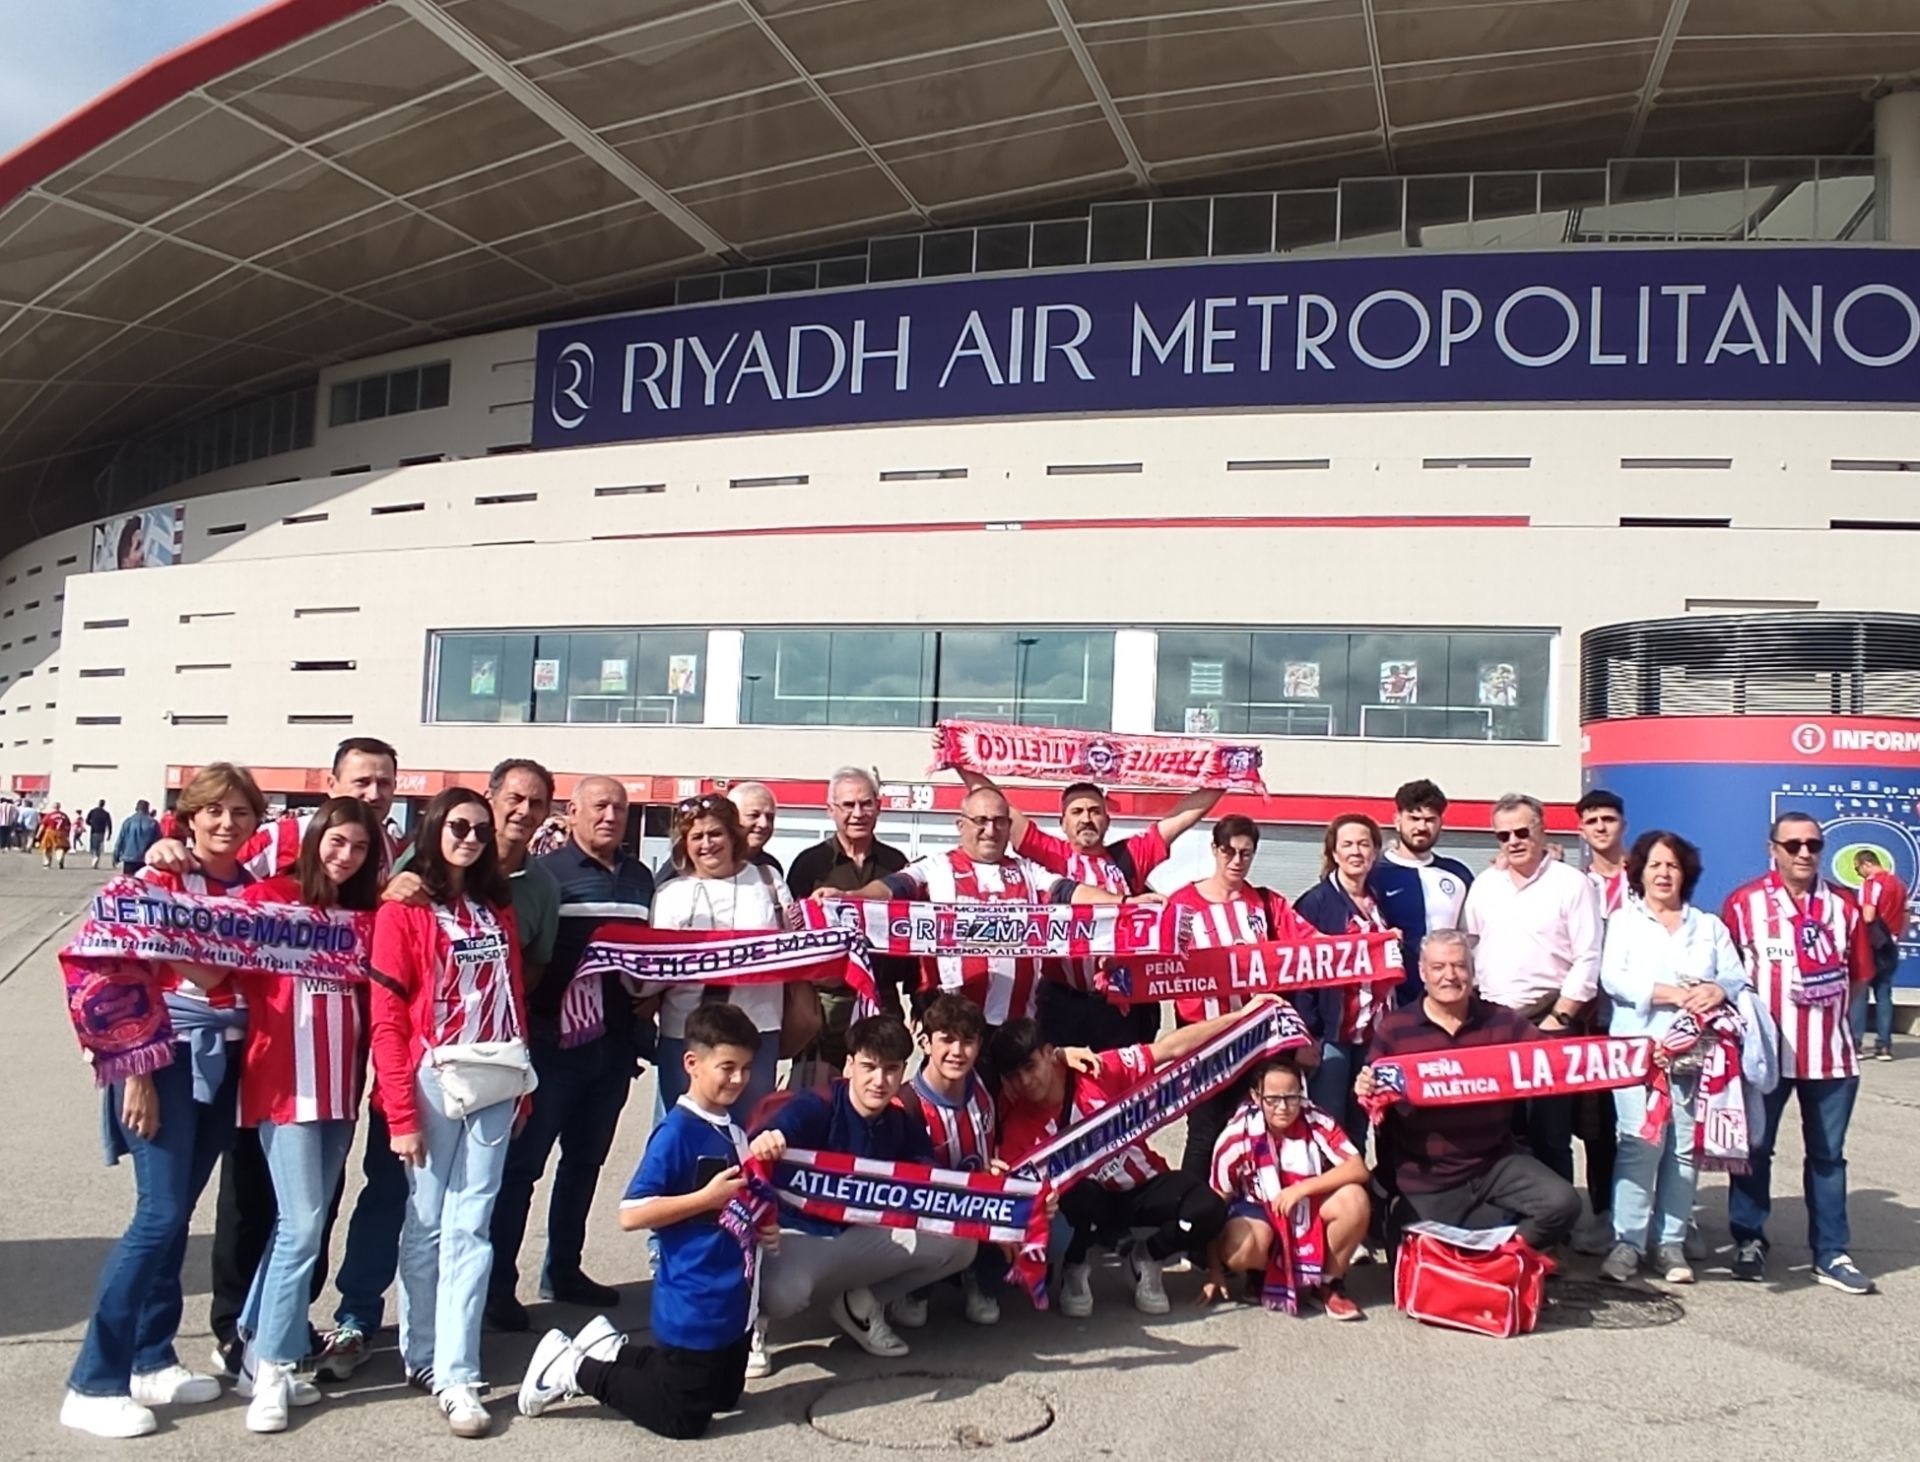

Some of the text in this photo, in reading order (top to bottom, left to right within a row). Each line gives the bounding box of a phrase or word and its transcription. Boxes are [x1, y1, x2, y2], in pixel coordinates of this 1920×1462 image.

[622, 316, 910, 413] RIYADH
[938, 304, 1095, 388] AIR
[1131, 283, 1920, 376] METROPOLITANO
[1131, 748, 1211, 775] FRENTE
[254, 915, 357, 951] MADRID
[890, 918, 1145, 942] GRIEZMANN 7
[730, 940, 766, 967] DE
[1145, 959, 1185, 975] PEÑA
[1229, 950, 1268, 988] LA
[1276, 939, 1374, 984] ZARZA
[1148, 976, 1218, 996] ATLÉTICA
[1416, 1058, 1464, 1078] PEÑA
[1509, 1048, 1555, 1090] LA
[1422, 1077, 1500, 1098] ATLÉTICA
[789, 1169, 1016, 1222] ATLÉTICO SIEMPRE
